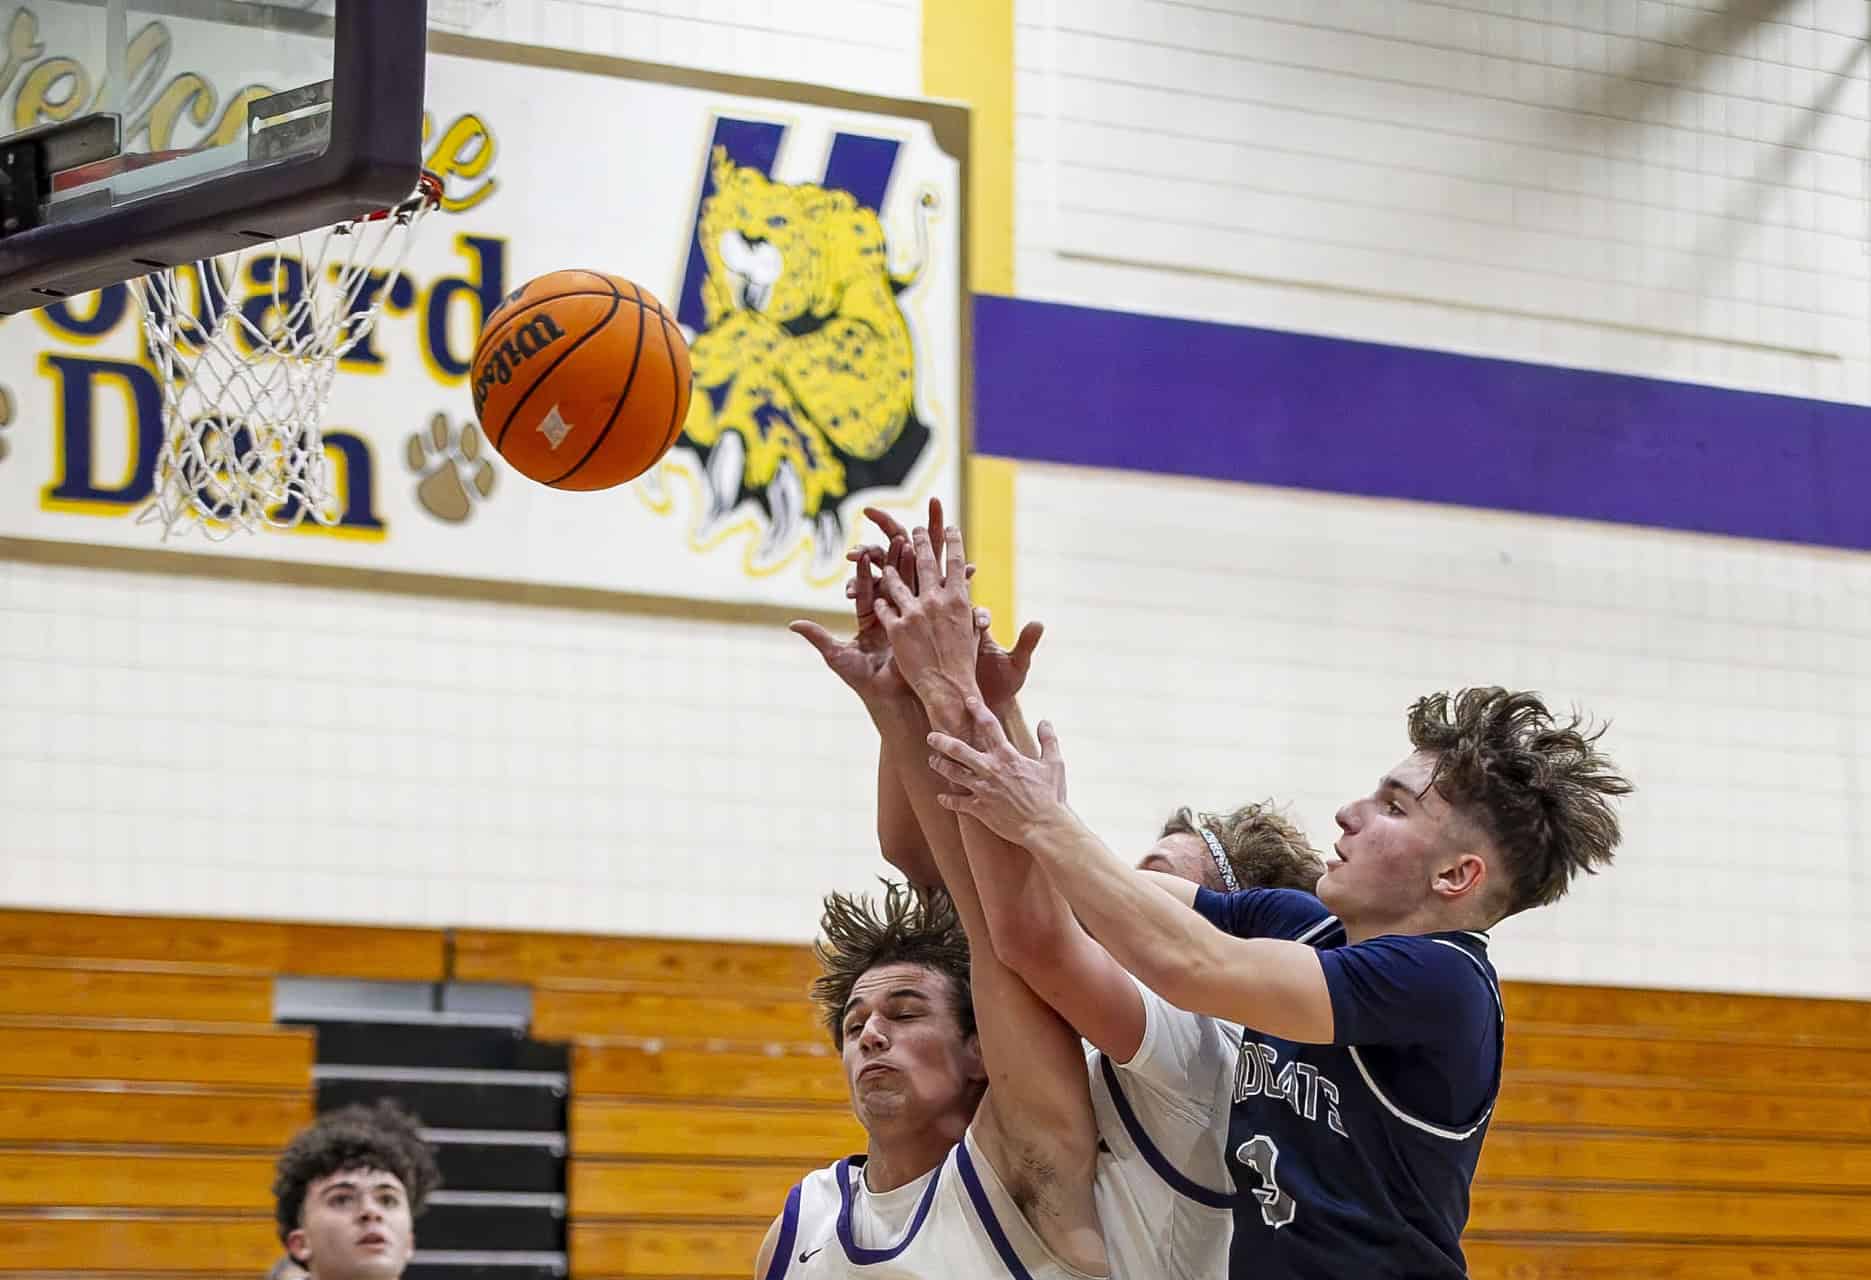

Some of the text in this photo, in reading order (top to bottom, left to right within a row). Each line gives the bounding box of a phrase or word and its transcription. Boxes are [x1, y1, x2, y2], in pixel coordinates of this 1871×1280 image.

[35, 354, 389, 541] Den
[1232, 1041, 1350, 1139] DCATS
[1235, 1134, 1297, 1230] 3
